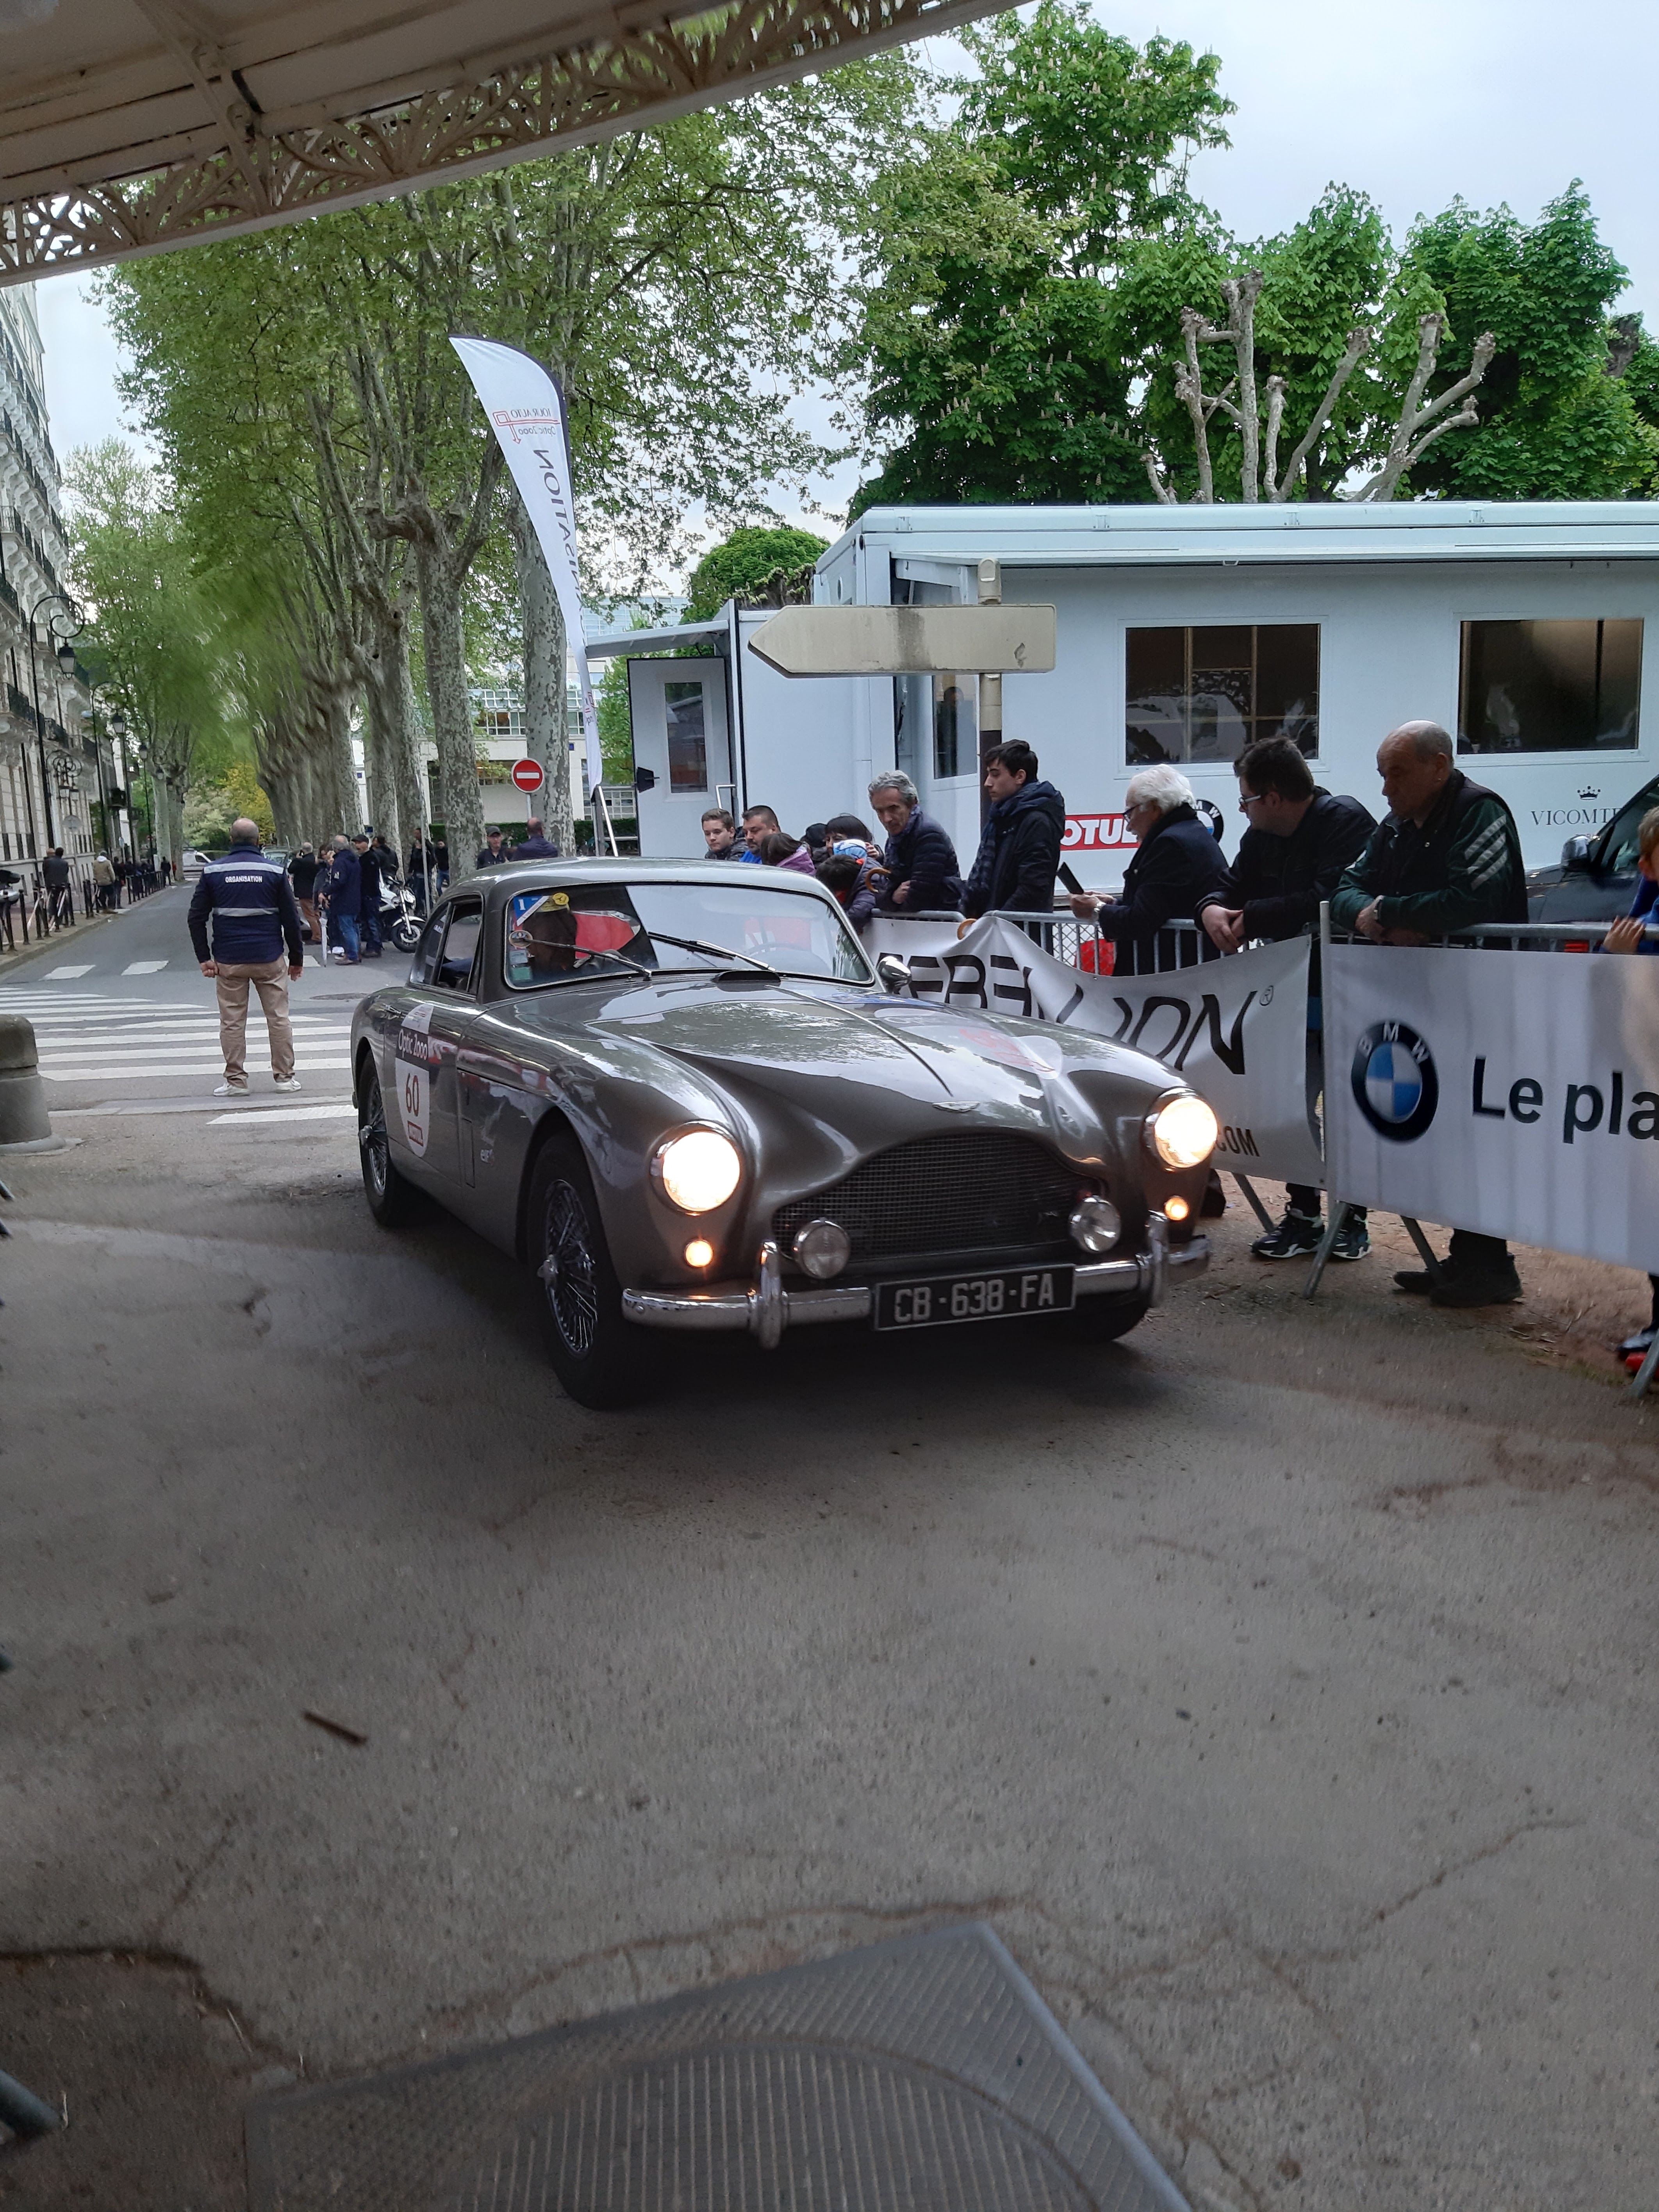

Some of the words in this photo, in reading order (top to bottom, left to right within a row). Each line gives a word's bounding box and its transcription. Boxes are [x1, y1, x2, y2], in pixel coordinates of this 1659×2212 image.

[1191, 800, 1220, 819] MW
[1060, 819, 1138, 846] OTUL
[398, 1029, 414, 1058] Optic
[1358, 1020, 1430, 1064] BMW
[406, 1072, 419, 1117] 60
[1473, 1055, 1543, 1124] Le
[1563, 1071, 1659, 1144] pla
